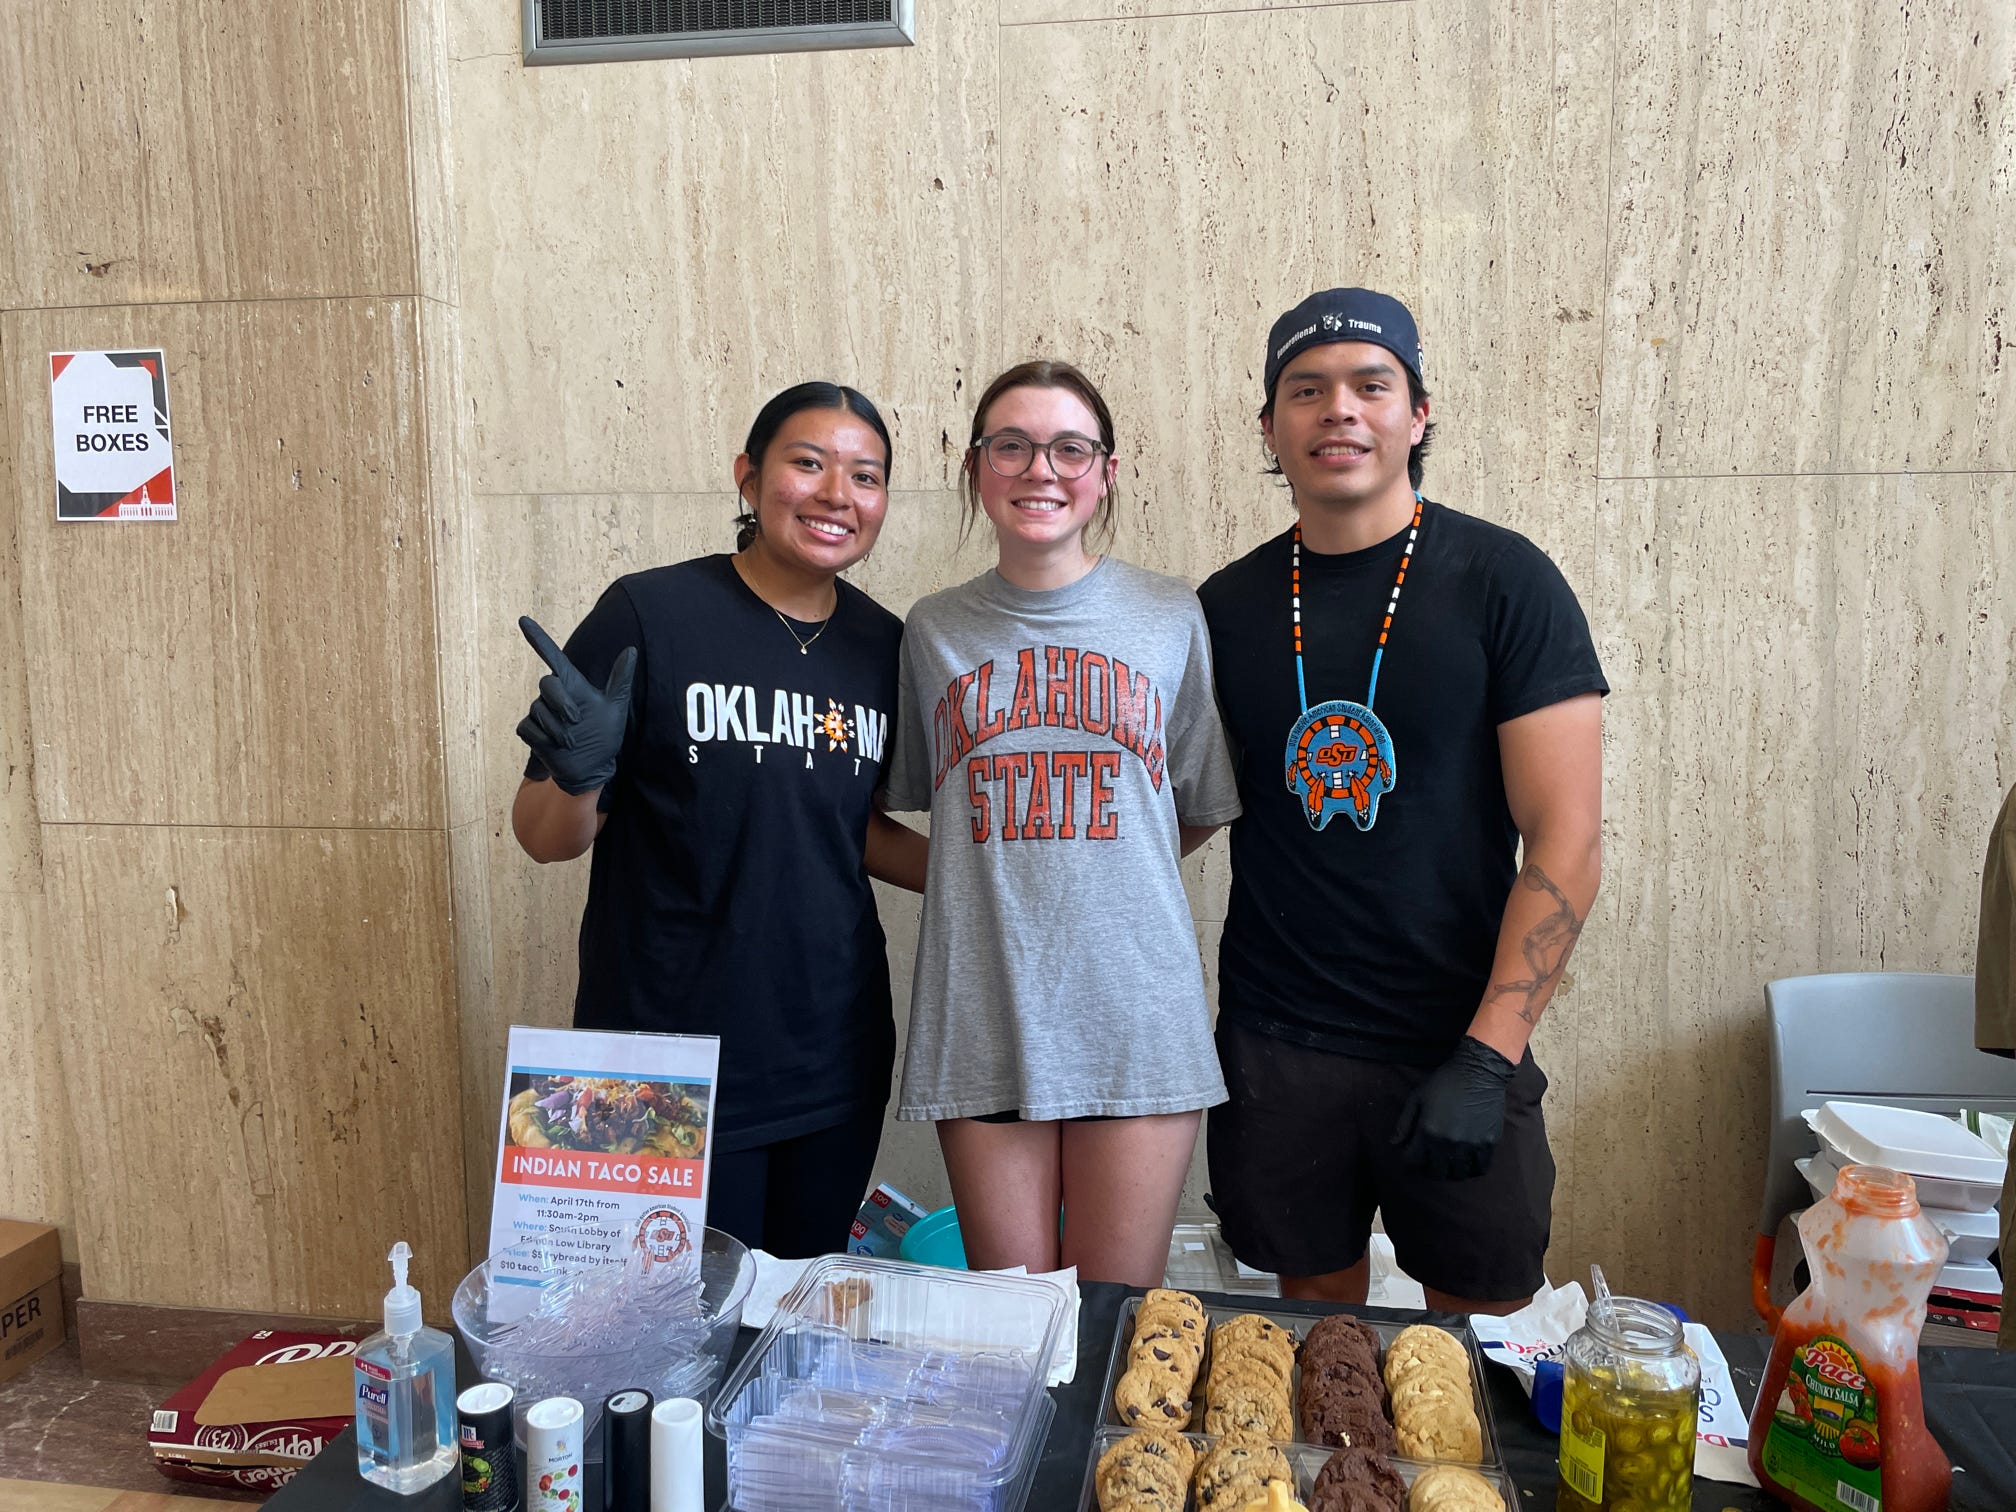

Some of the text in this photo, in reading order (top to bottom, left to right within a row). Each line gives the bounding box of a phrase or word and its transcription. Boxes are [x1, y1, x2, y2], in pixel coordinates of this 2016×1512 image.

[1348, 319, 1382, 334] Trauma
[83, 405, 139, 424] FREE
[76, 433, 149, 452] BOXES
[934, 644, 1164, 795] OKLAHOMA
[1316, 742, 1358, 767] OSU
[967, 750, 1122, 844] STATE
[512, 1155, 694, 1187] INDIAN TACO SALE
[518, 1193, 620, 1210] When: April 17th from
[536, 1209, 599, 1223] 11:30am-2pm
[512, 1220, 547, 1232] Where:
[579, 1227, 606, 1239] Lobby
[610, 1229, 621, 1238] of
[555, 1238, 575, 1249] Low
[577, 1240, 611, 1253] Library
[500, 1260, 516, 1270] $10
[531, 1249, 543, 1260] $5
[588, 1255, 600, 1266] by
[0, 1296, 41, 1339] PER
[1803, 1347, 1867, 1390] Pace
[362, 1384, 387, 1405] Purell
[1805, 1374, 1859, 1408] CHUNKY SALSA
[212, 1429, 231, 1450] 23
[1813, 1433, 1836, 1450] MILD
